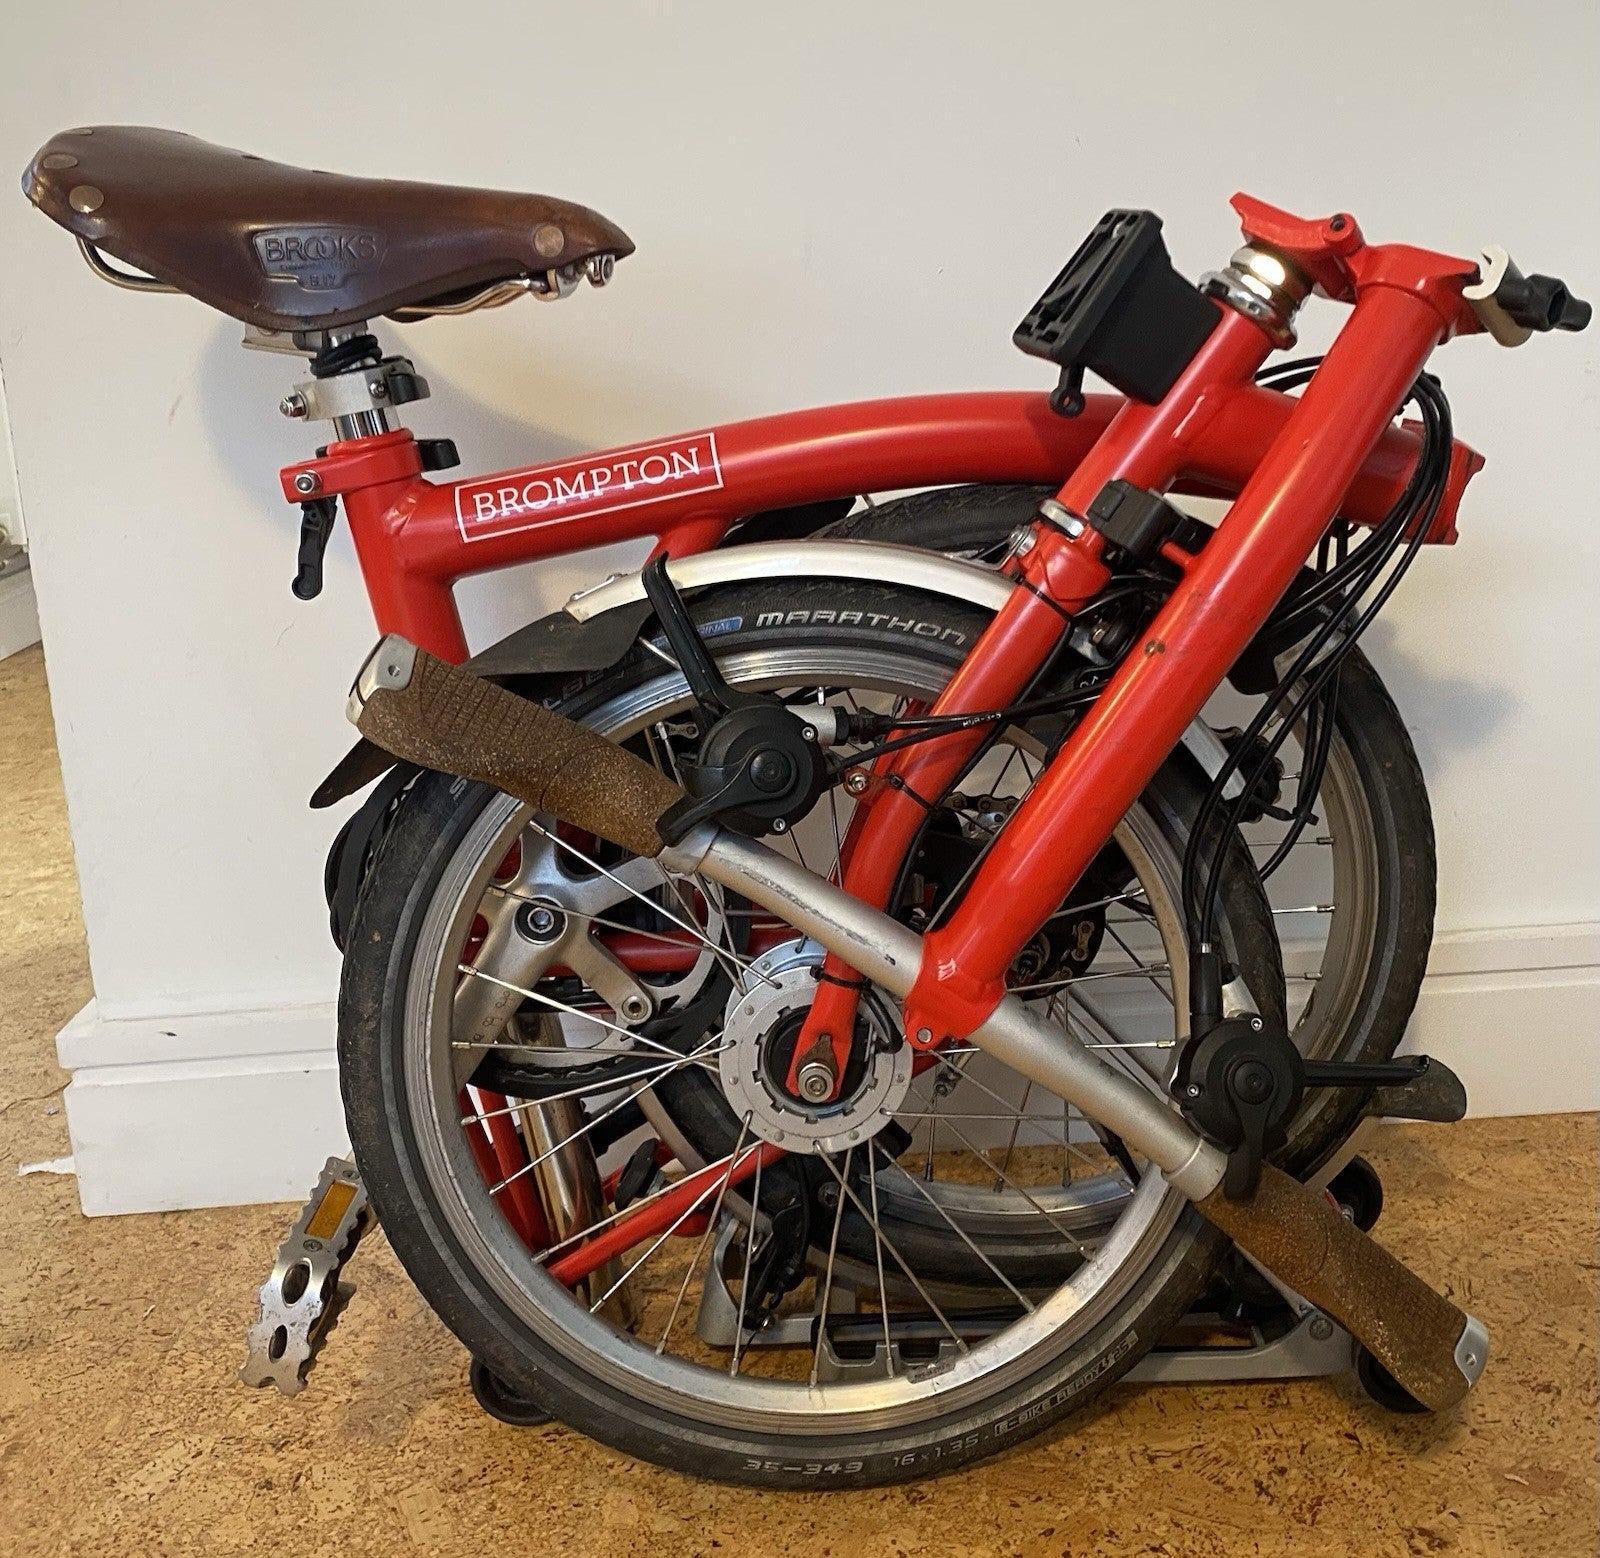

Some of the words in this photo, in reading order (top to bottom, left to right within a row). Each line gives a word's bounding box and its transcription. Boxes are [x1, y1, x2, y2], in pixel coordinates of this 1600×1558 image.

[265, 235, 378, 261] BROOKS
[472, 446, 701, 523] BROMPTON
[755, 610, 967, 646] MARATHON
[742, 1459, 864, 1475] 35-349
